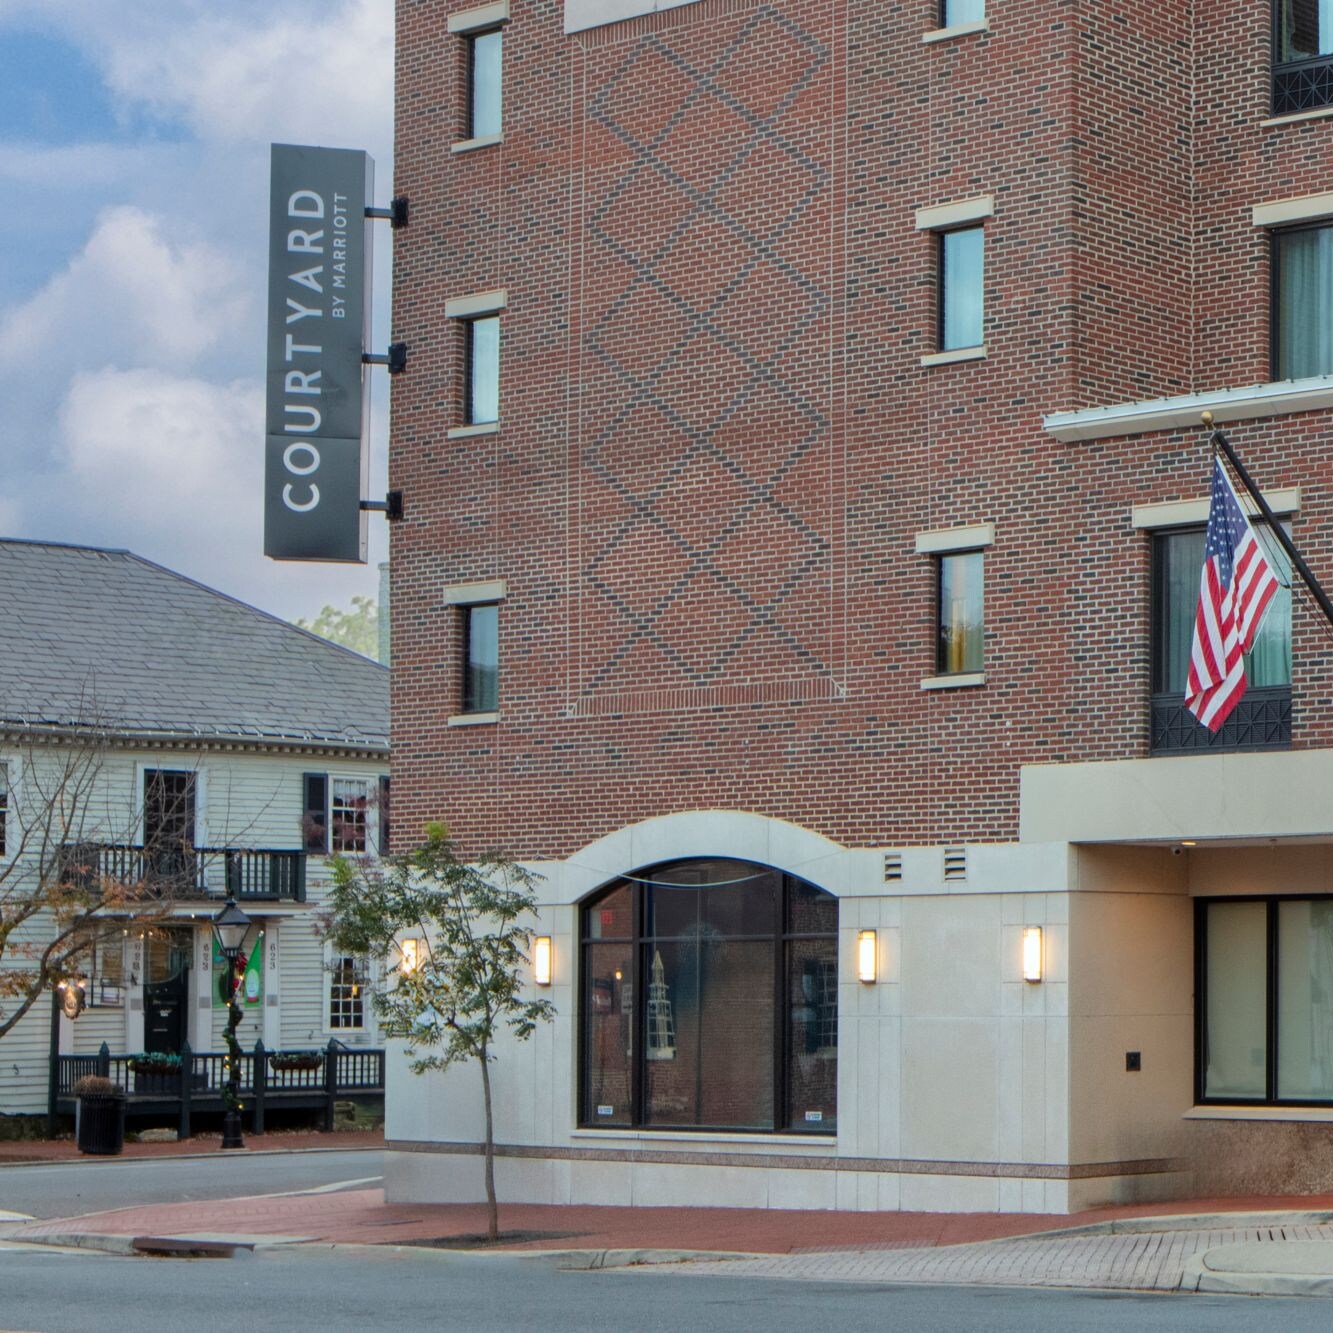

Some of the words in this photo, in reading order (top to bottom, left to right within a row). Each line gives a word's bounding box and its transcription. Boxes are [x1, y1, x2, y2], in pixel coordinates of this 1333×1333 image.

[333, 192, 347, 288] MARRIOTT
[283, 189, 324, 512] COURTYARD
[332, 295, 345, 318] BY
